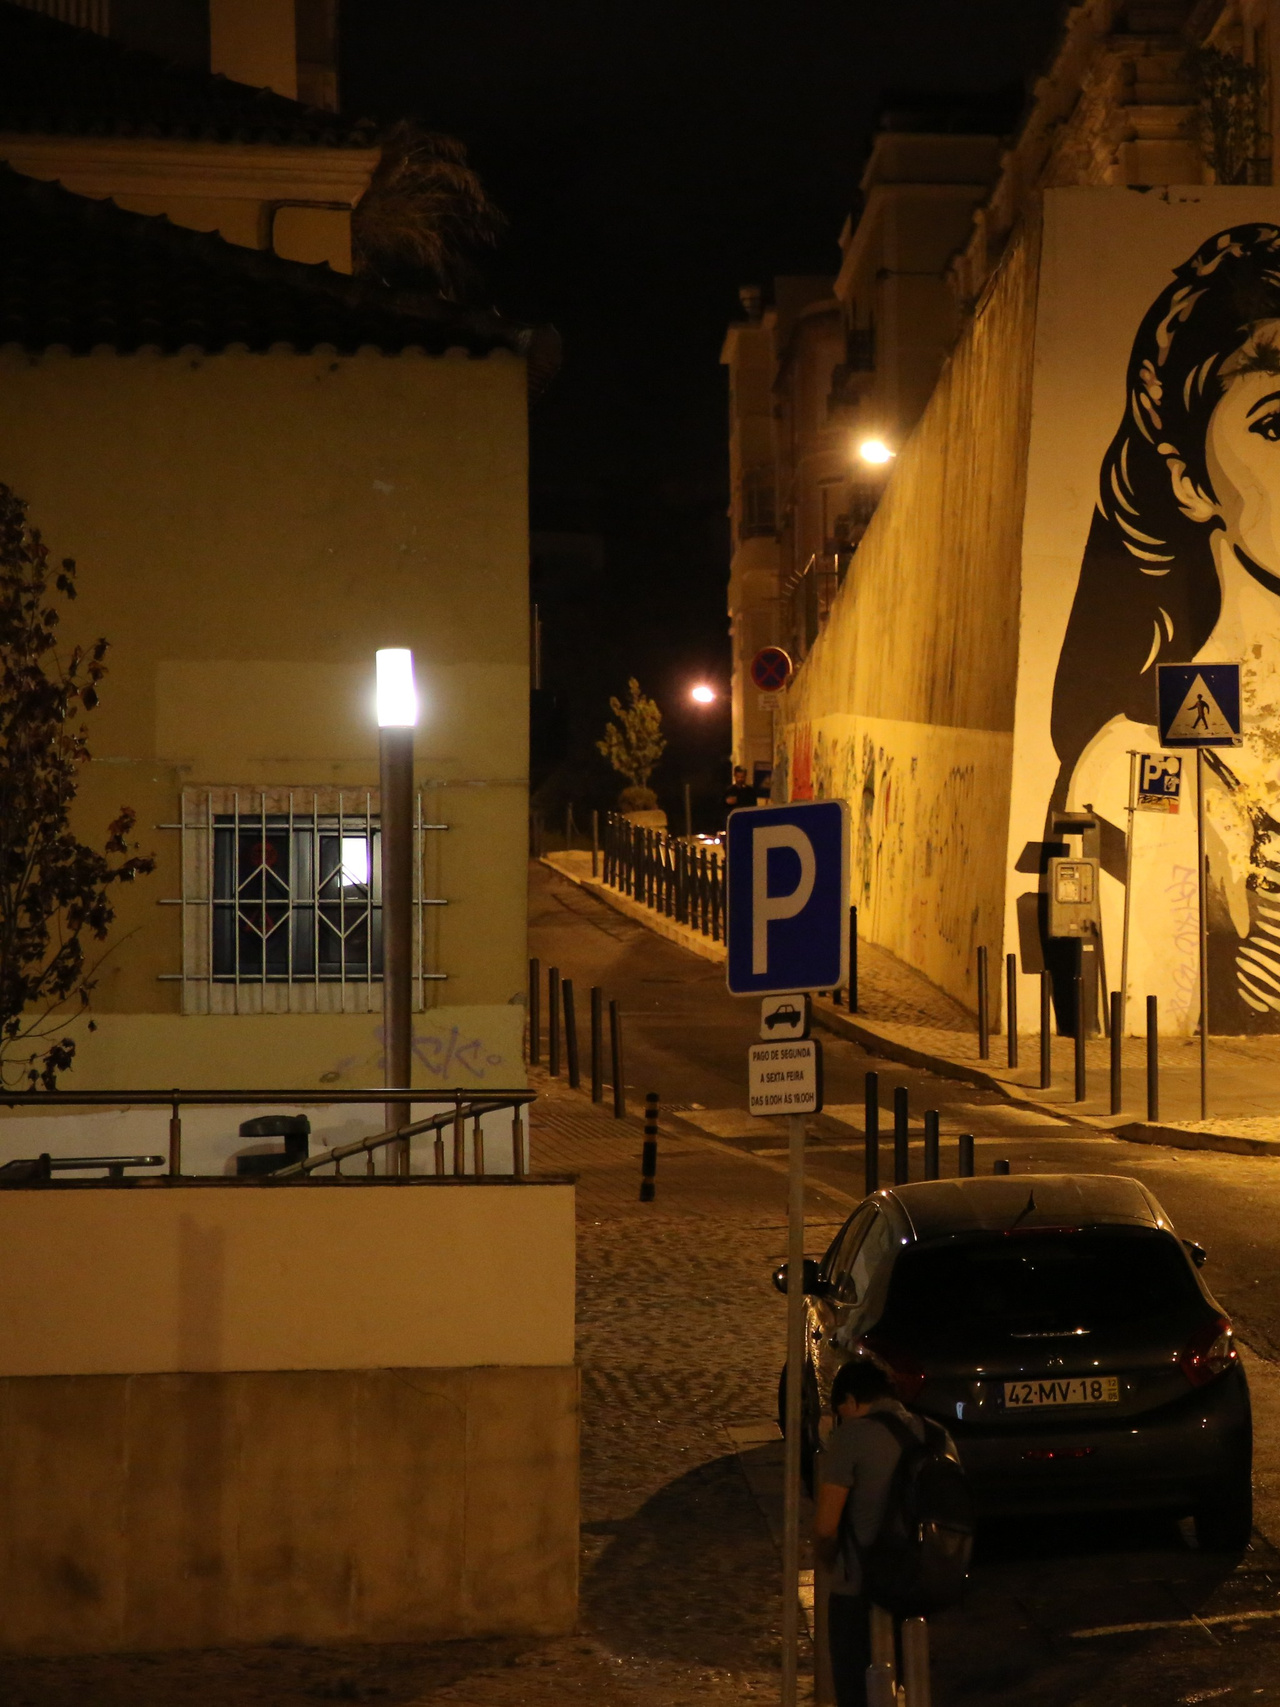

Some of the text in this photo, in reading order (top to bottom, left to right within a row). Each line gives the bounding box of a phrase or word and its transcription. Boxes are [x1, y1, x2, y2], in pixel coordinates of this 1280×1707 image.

[1143, 758, 1162, 790] P
[752, 824, 816, 975] P
[753, 1047, 811, 1062] PAGO DE SEGUNDA
[760, 1070, 804, 1083] A SEXTA FEIRA
[751, 1095, 764, 1107] DAS
